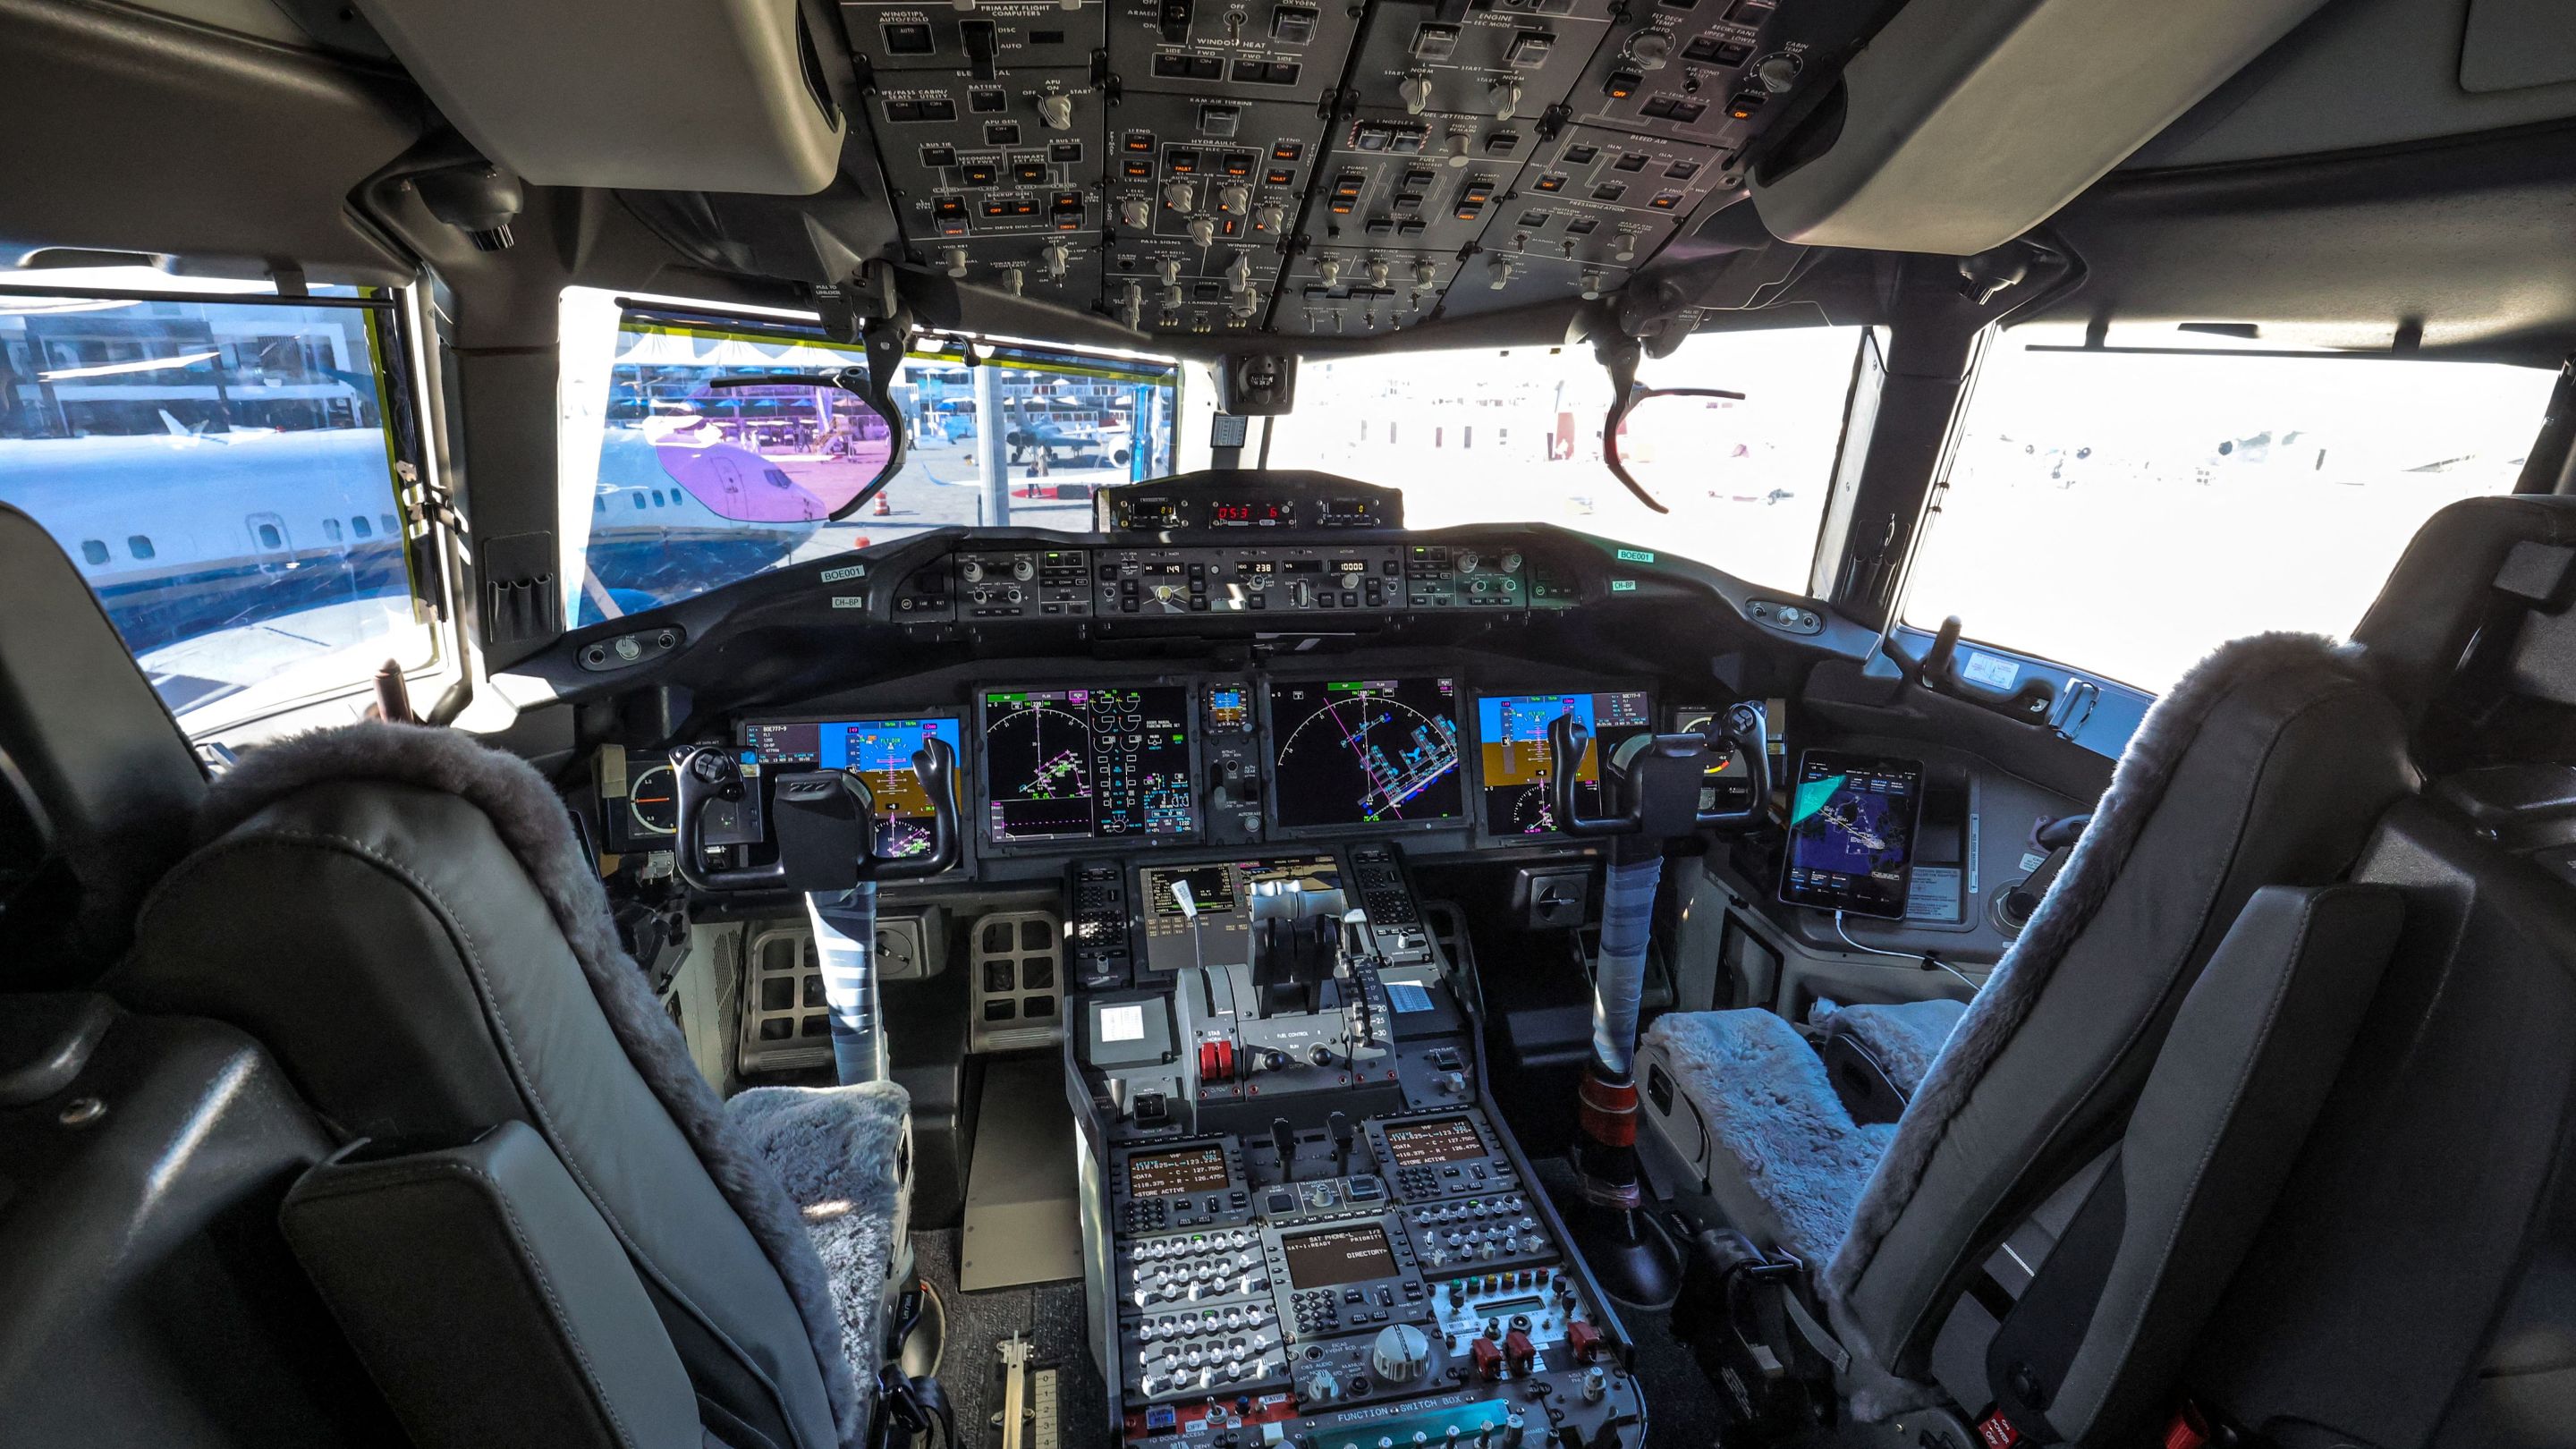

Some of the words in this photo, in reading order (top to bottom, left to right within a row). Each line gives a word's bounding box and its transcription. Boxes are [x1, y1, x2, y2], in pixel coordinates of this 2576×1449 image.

[1479, 13, 1513, 21] ENGINE
[1712, 24, 1734, 35] RECIRC
[1735, 29, 1756, 38] FANS
[1731, 35, 1757, 44] LOWER
[1786, 41, 1809, 49] CABIN
[1630, 134, 1650, 142] BLEED
[1569, 200, 1625, 213] PRESSURIZATION
[1621, 551, 1650, 561] BOE001
[1256, 564, 1271, 572] 238
[824, 568, 863, 580] BOE001
[835, 598, 859, 606] CH-BP
[791, 782, 831, 792] 777
[1325, 1233, 1353, 1241] PHONE-L
[1350, 1234, 1382, 1242] PRIORITY
[1337, 1408, 1388, 1422] FUNCTION
[1399, 1400, 1437, 1412] SWITCH
[1442, 1395, 1462, 1404] BOX
[1187, 1423, 1202, 1431] OFF
[1991, 1419, 2009, 1444] POWER
[1987, 1431, 1998, 1445] OFF
